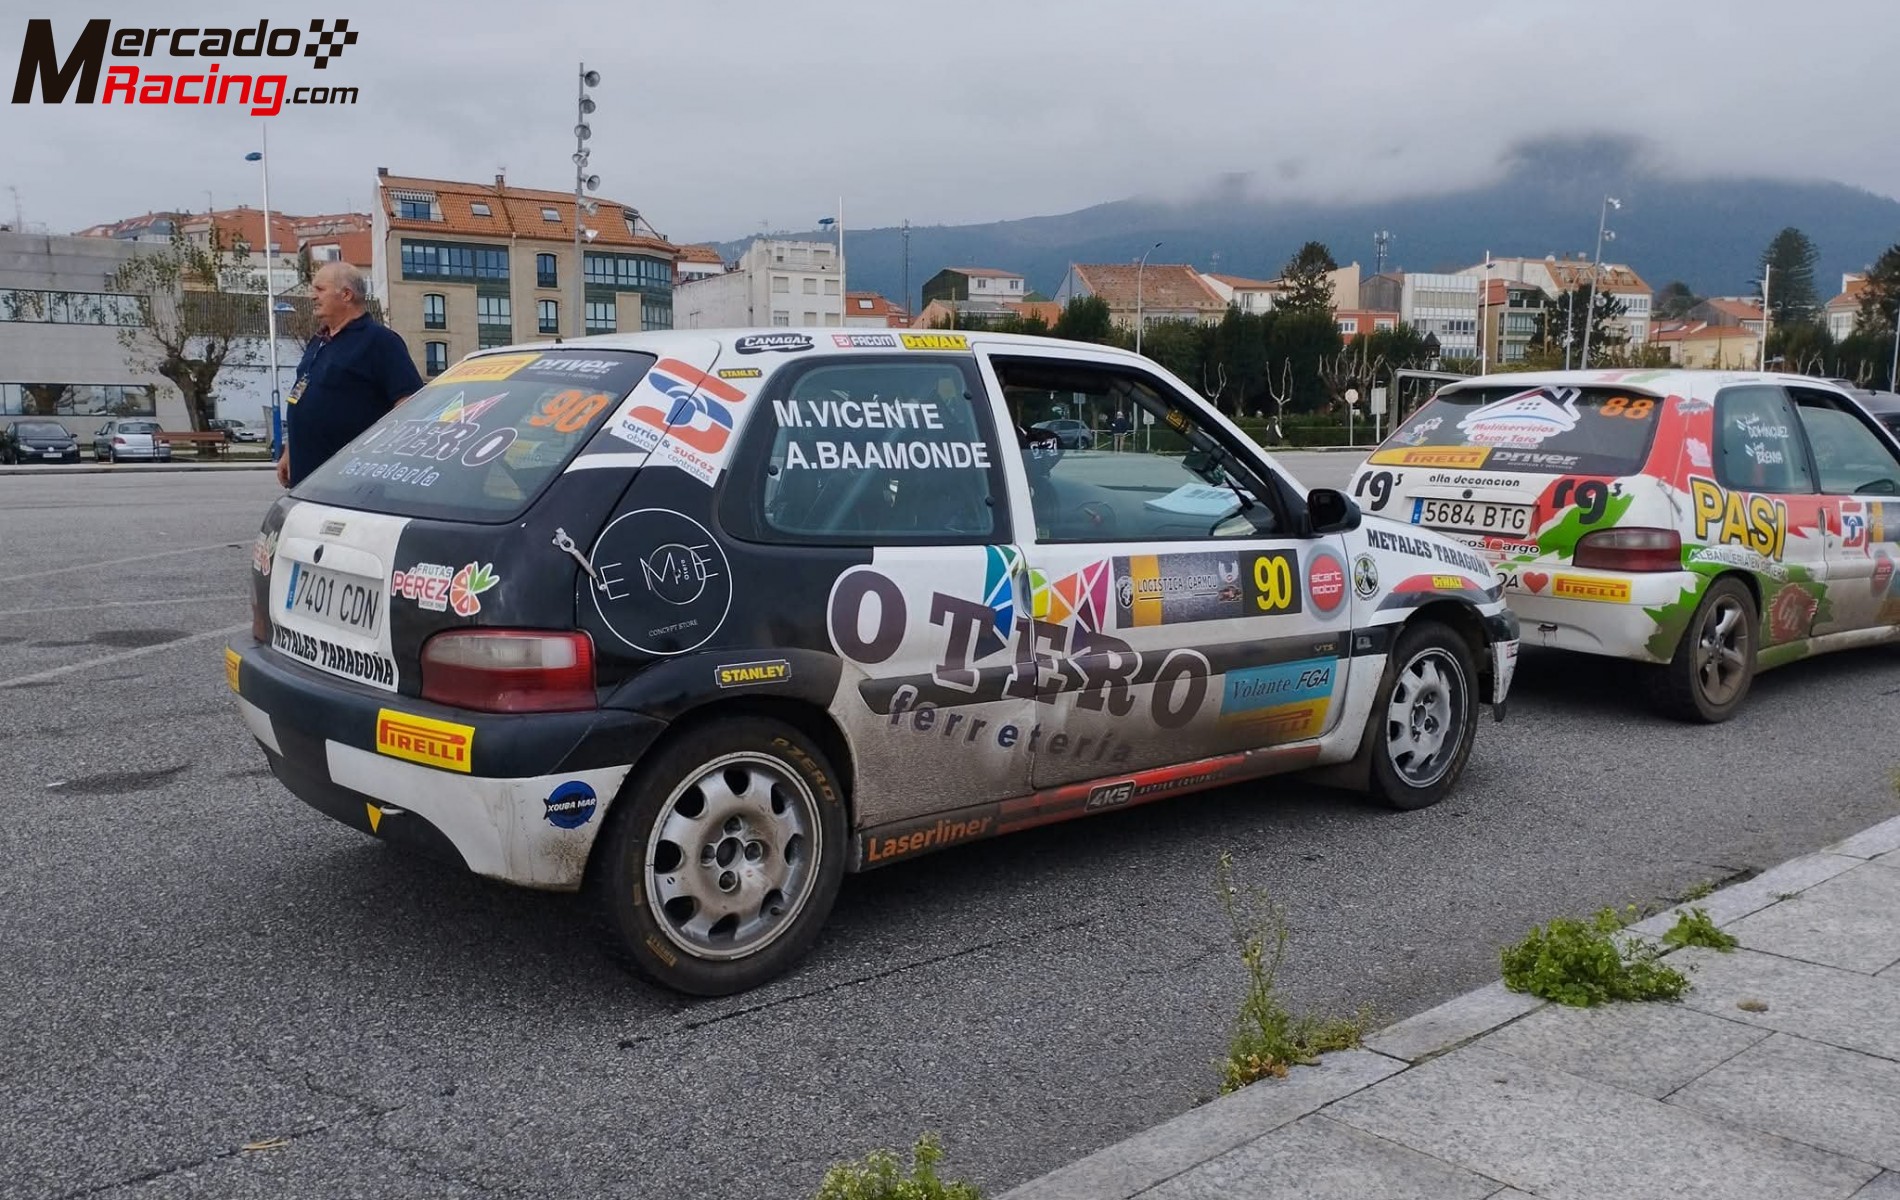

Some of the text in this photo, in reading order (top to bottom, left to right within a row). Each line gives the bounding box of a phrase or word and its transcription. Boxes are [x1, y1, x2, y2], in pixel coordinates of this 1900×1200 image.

[719, 369, 760, 378] STANLEY
[530, 389, 610, 433] 90
[1601, 396, 1655, 419] 88
[667, 454, 711, 483] contratas
[785, 440, 992, 470] A.BAAMONDE
[1403, 451, 1481, 463] PIRELLI
[1429, 473, 1451, 484] alta
[1424, 502, 1475, 525] 5684
[1483, 507, 1526, 530] BTG
[1689, 475, 1787, 562] PASI
[1366, 528, 1433, 559] METALES
[418, 564, 452, 577] FRUTAS
[1138, 578, 1183, 592] LOGISTICA
[1254, 556, 1292, 610] 90
[295, 570, 334, 617] 7401
[339, 583, 380, 630] CDN
[1556, 578, 1628, 598] PIRELLI
[273, 623, 394, 686] METALES TARAGOÑA
[828, 568, 1211, 728] OTERO
[721, 665, 785, 683] STANLEY
[1232, 668, 1330, 700] Volante FGA
[379, 719, 467, 761] PIRELLI
[548, 799, 596, 812] XOUBA MAR
[868, 815, 993, 861] Laserliner
